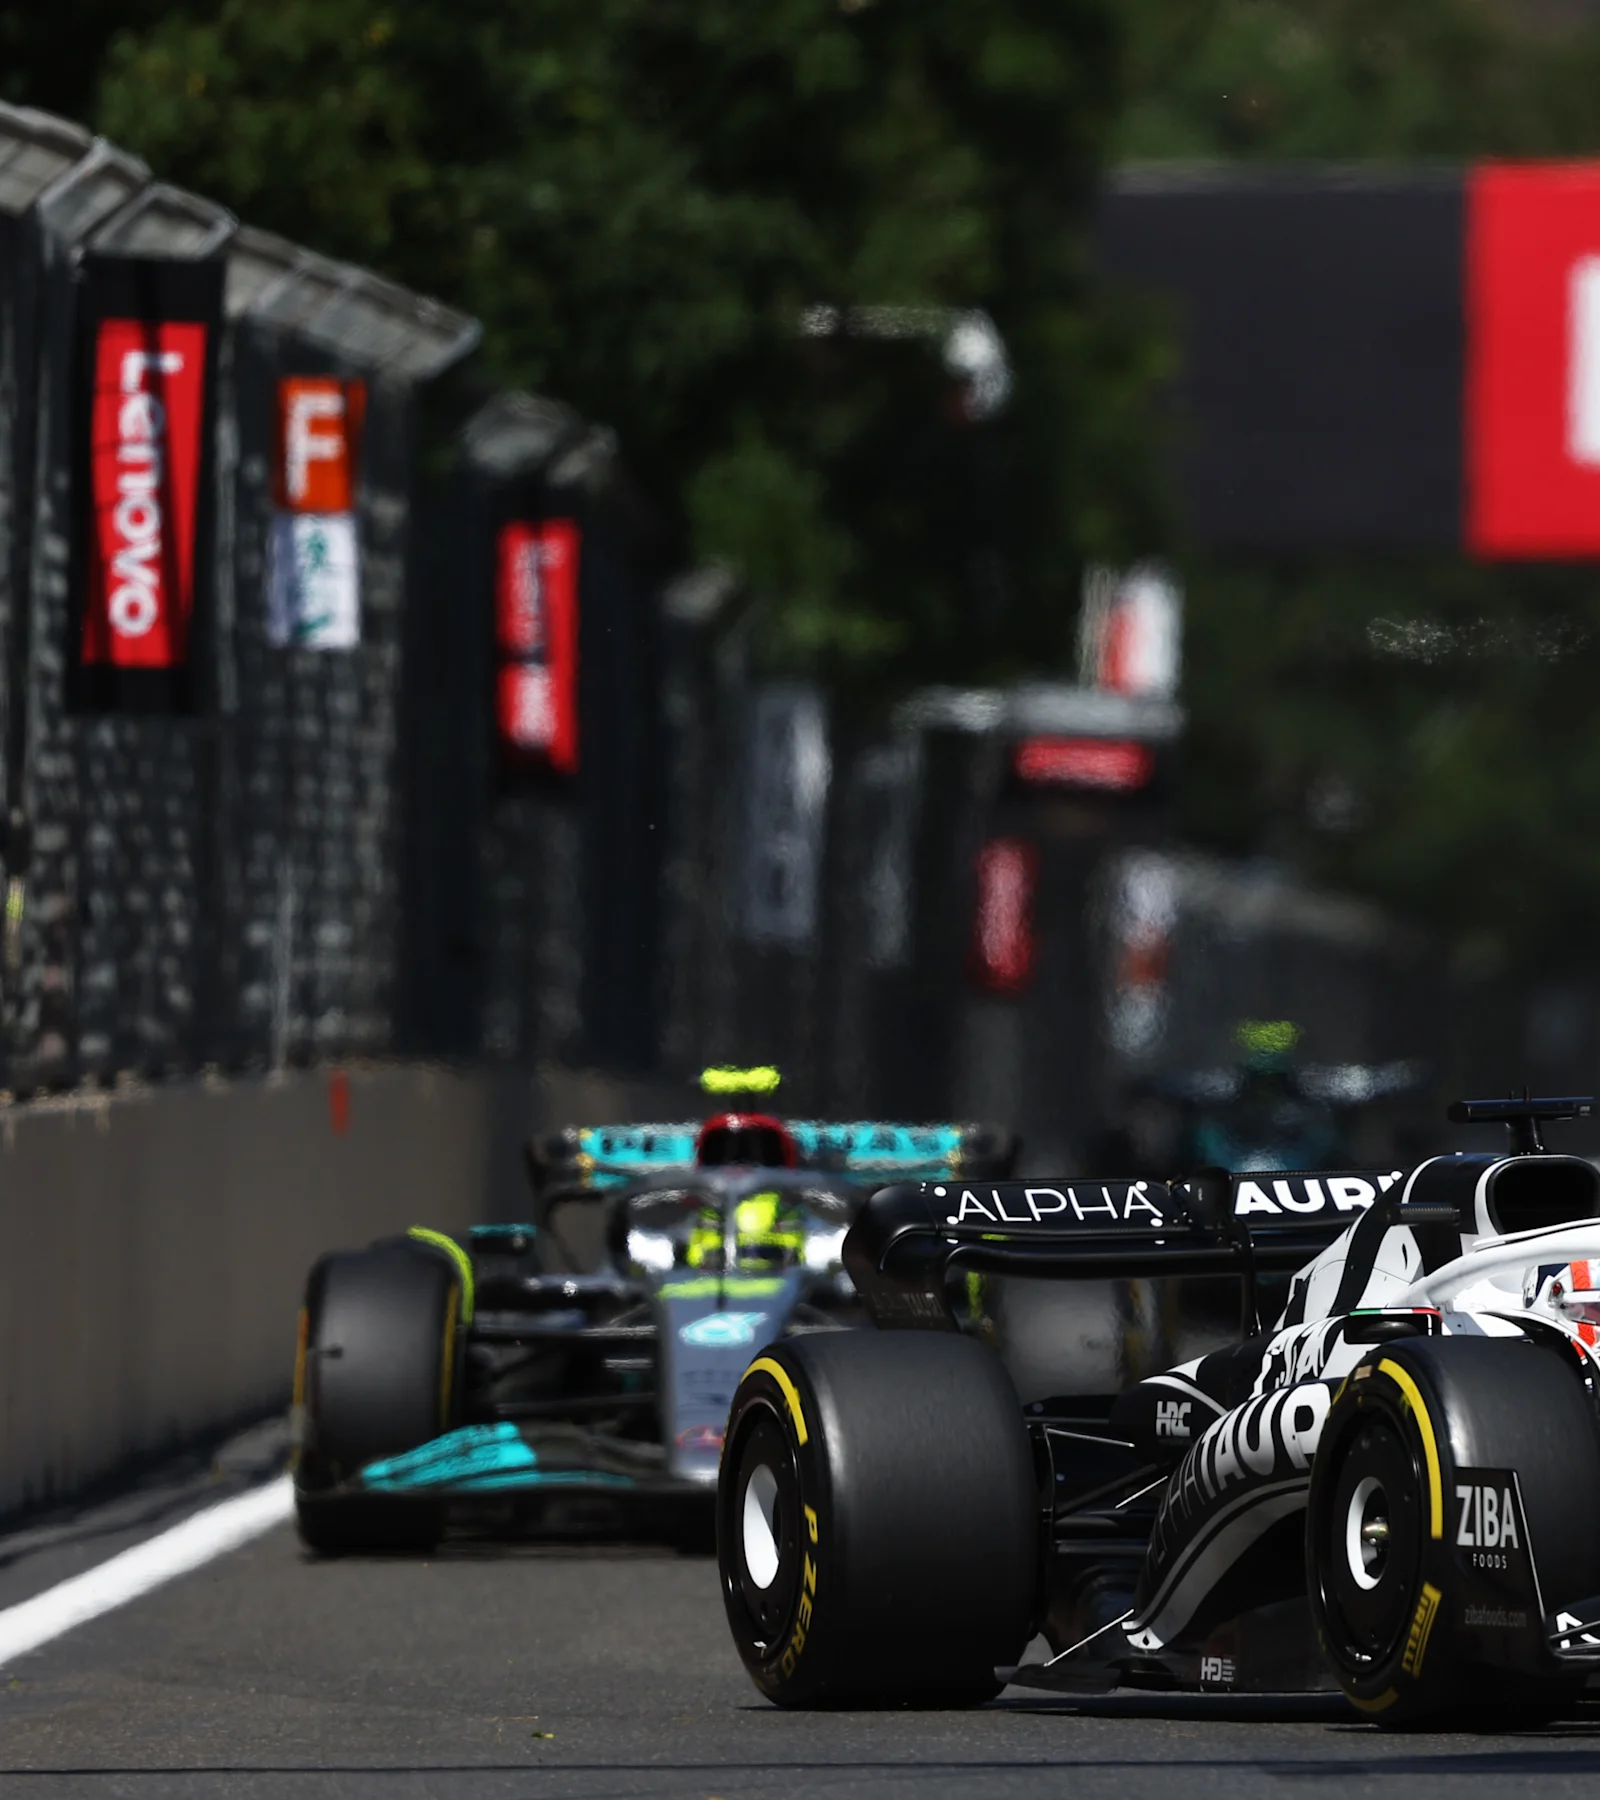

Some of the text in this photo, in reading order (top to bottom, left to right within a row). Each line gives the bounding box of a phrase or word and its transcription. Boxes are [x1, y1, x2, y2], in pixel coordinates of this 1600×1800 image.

[110, 350, 183, 638] Lenovo
[1456, 1485, 1519, 1549] ZIBA
[782, 1503, 818, 1680] P ZERO
[1473, 1553, 1507, 1569] FOODS
[1465, 1604, 1527, 1627] zibafoods.com
